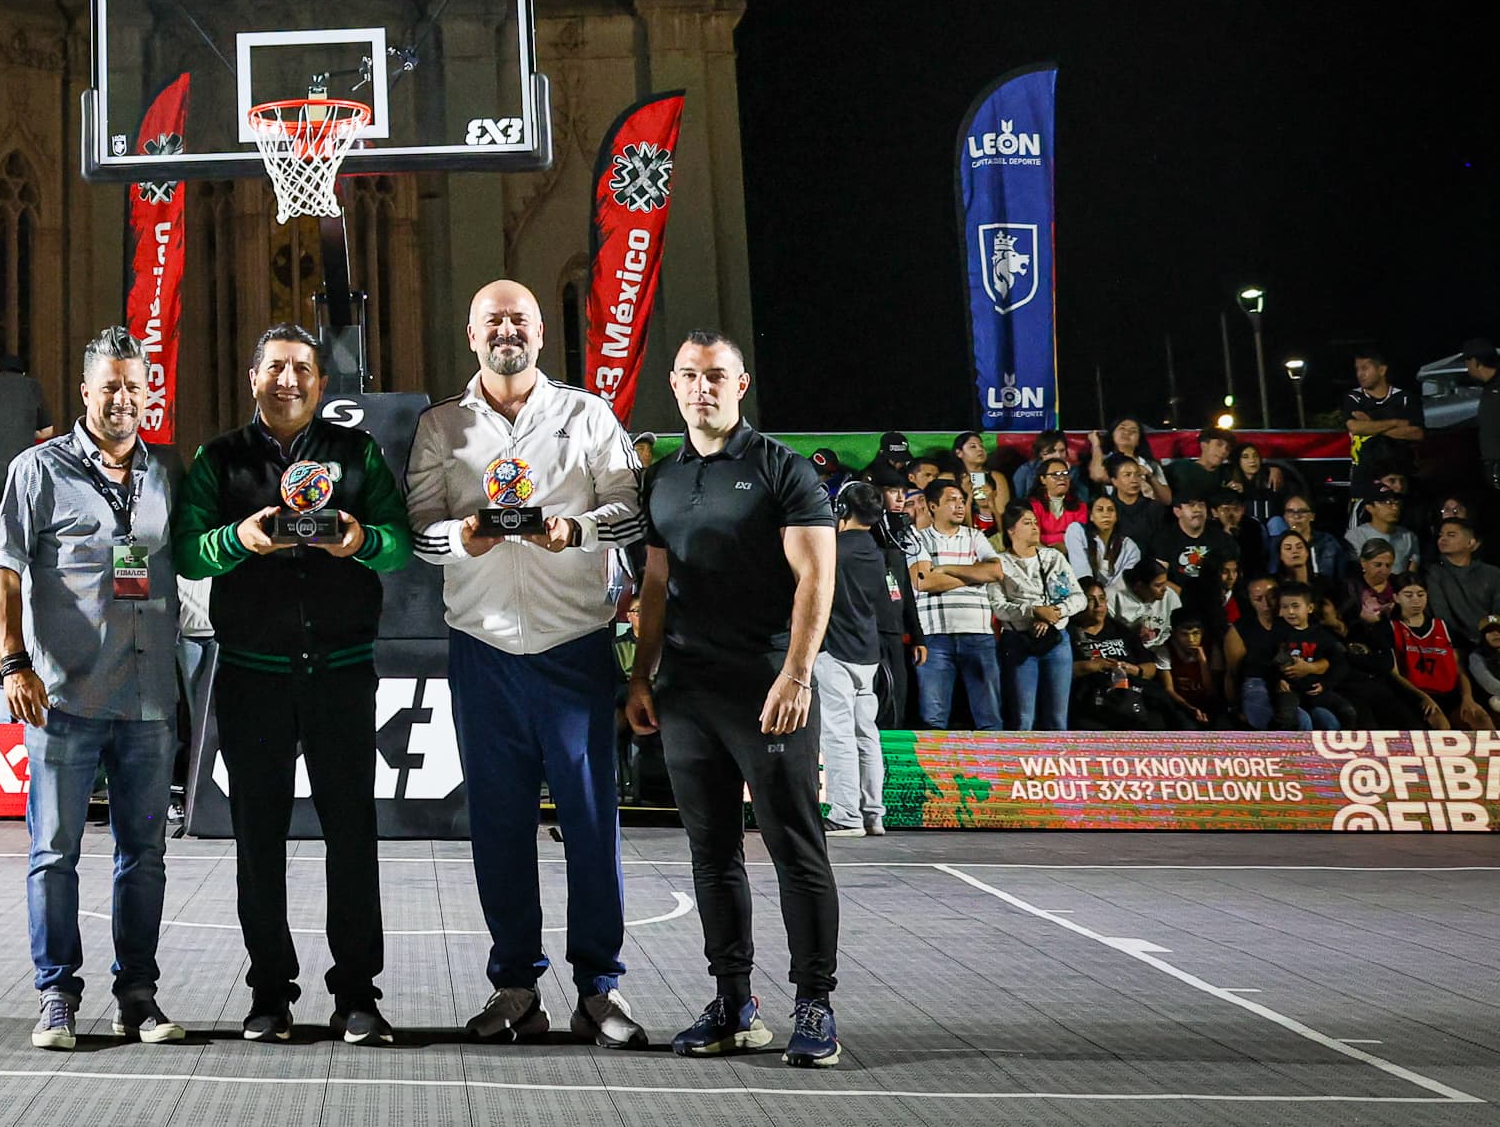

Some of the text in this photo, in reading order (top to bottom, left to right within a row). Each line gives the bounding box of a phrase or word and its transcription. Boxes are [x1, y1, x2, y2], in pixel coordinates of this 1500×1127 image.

[601, 229, 650, 358] México
[1019, 757, 1284, 777] WANT TO KNOW MORE
[1010, 780, 1303, 802] ABOUT 3X3? FOLLOW US
